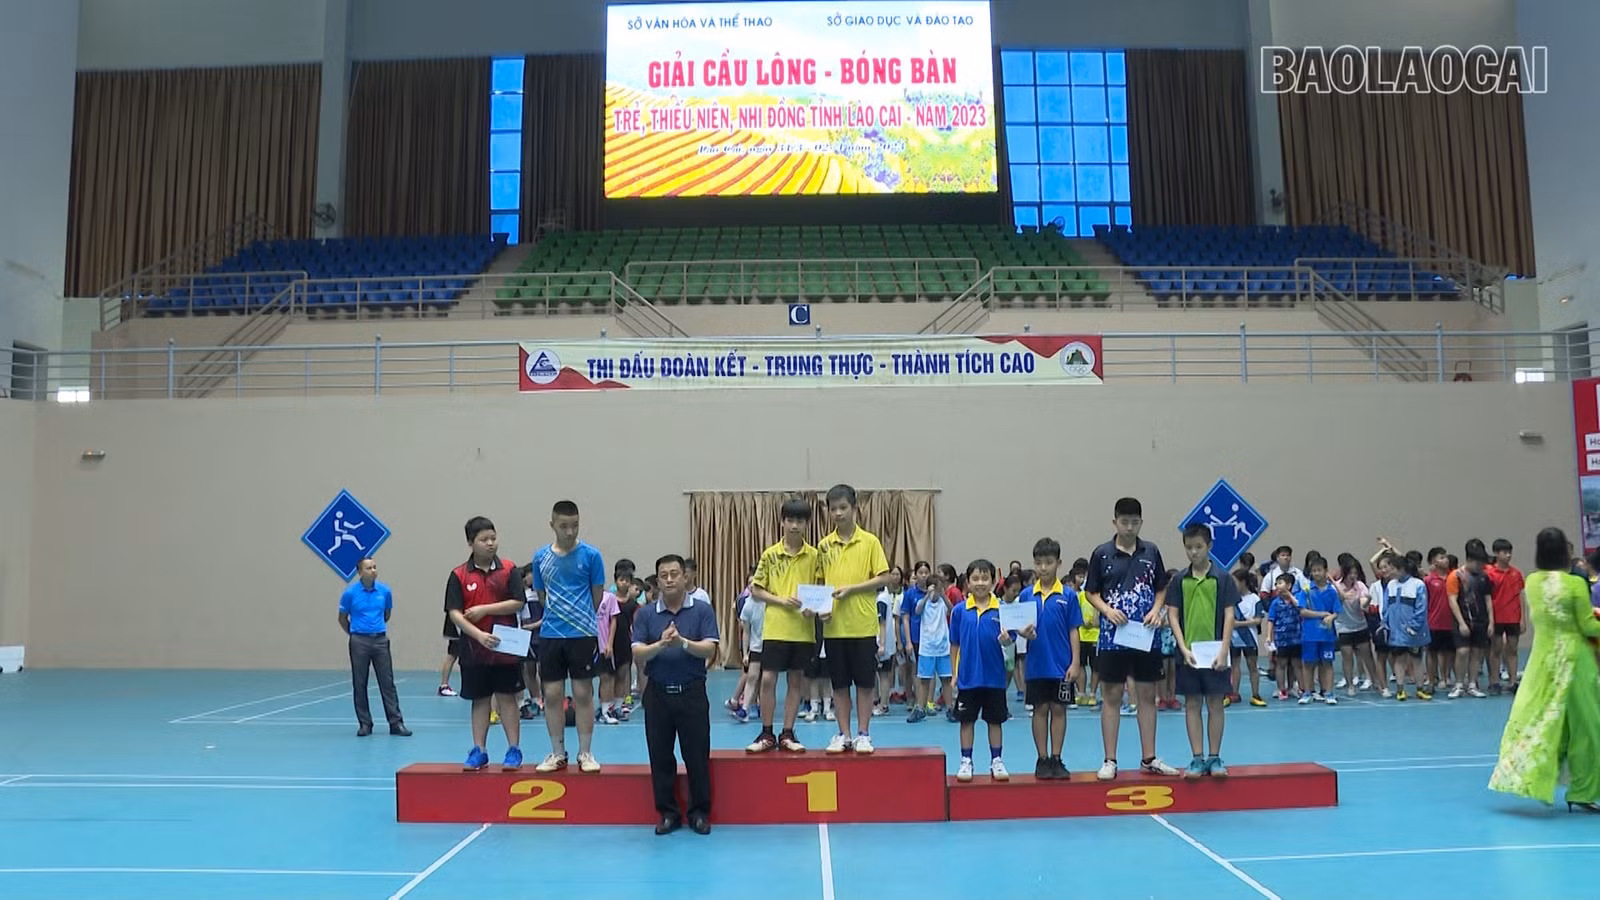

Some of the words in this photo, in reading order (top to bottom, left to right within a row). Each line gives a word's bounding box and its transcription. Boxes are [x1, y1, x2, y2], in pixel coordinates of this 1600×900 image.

[743, 16, 773, 27] THAO
[877, 15, 901, 27] DỤC
[648, 50, 695, 88] GIẢI
[703, 48, 748, 87] CẦU
[756, 51, 816, 86] LÔNG
[840, 49, 901, 85] BÓNG
[911, 49, 957, 84] BÀN
[614, 101, 646, 134] TRẺ,
[651, 99, 692, 130] THIẾU
[697, 101, 734, 132] NIÊN,
[739, 107, 762, 128] NHI
[767, 97, 805, 128] ĐỒNG
[810, 97, 842, 127] TỈNH
[848, 99, 874, 127] LÀO
[879, 106, 901, 127] CAI
[916, 101, 946, 127] NĂM
[951, 105, 986, 126] 2023
[791, 306, 808, 324] C
[587, 358, 613, 379] THI
[619, 351, 654, 378] ĐẤU
[661, 353, 709, 379] ĐOÀN
[714, 349, 747, 377] KẾT
[764, 355, 823, 377] TRUNG
[828, 353, 874, 380] THỰC
[891, 350, 950, 375] THÀNH
[955, 349, 994, 374] TÍCH
[1000, 352, 1034, 374] CAO
[508, 778, 566, 819] 2
[786, 770, 838, 812] 1
[1105, 785, 1175, 811] 3
